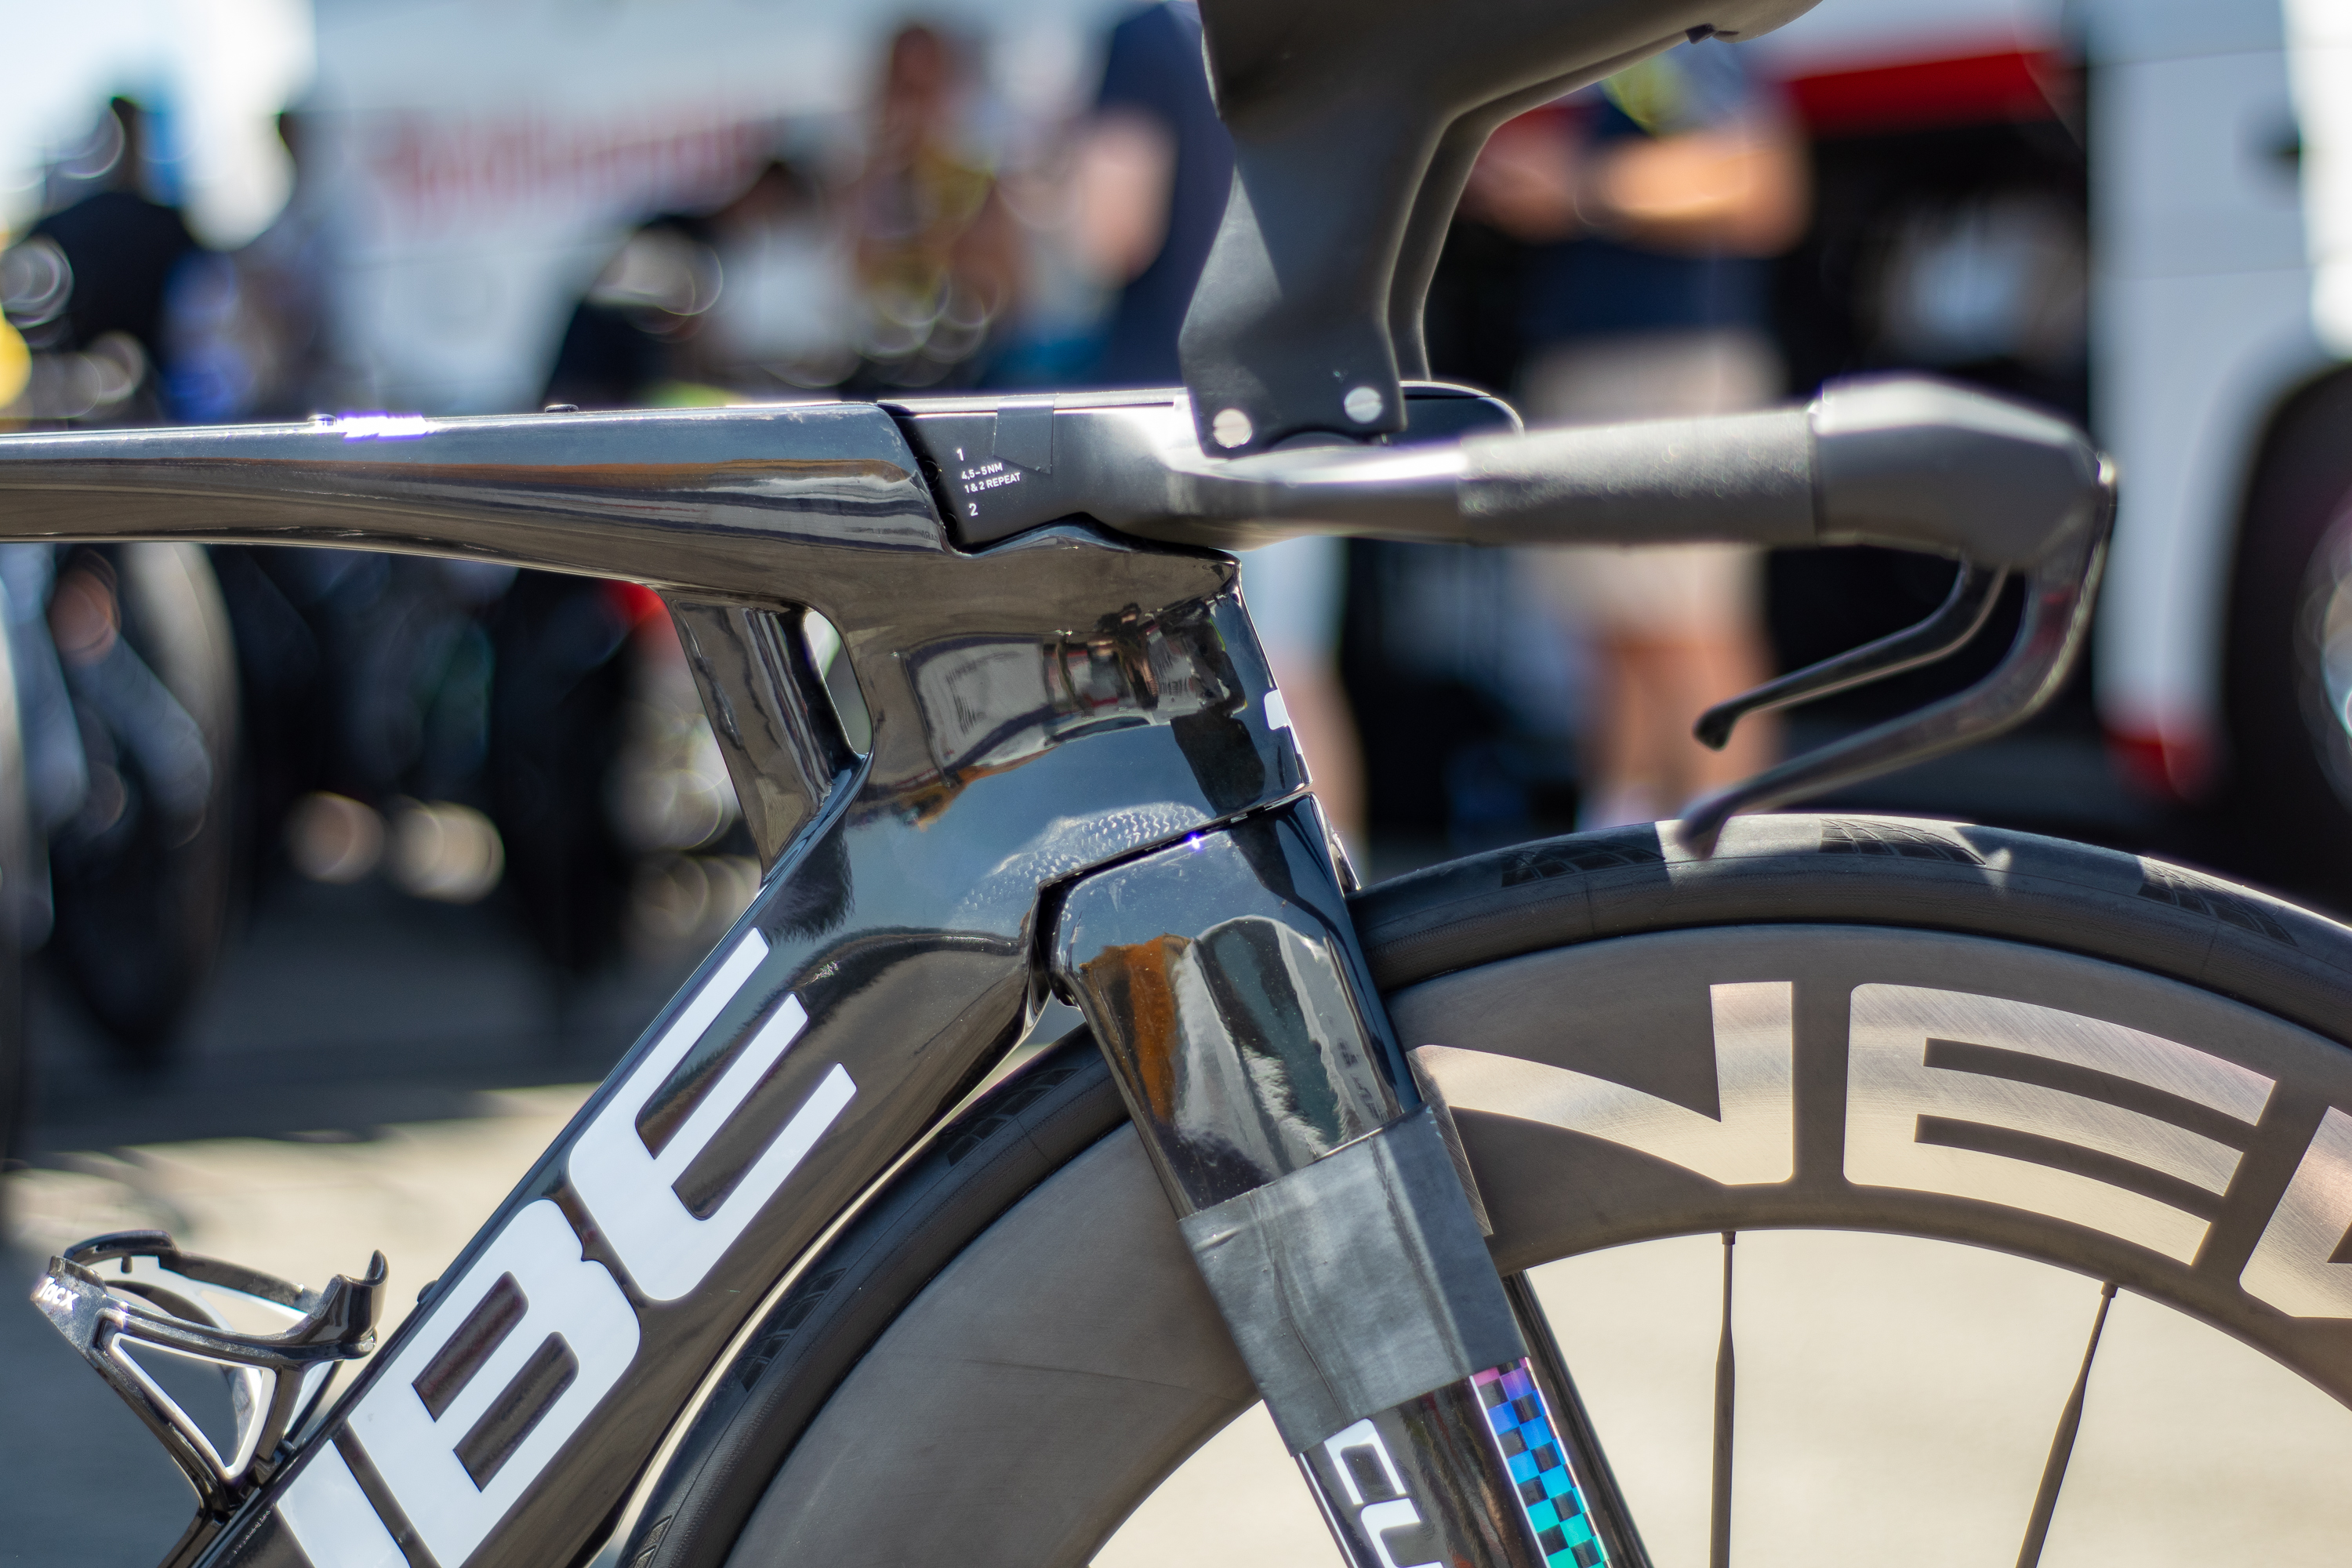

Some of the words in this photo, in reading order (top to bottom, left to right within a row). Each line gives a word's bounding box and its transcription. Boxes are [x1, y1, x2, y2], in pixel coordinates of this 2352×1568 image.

[956, 448, 964, 462] 1
[964, 485, 970, 494] 1
[971, 483, 978, 492] &
[978, 481, 985, 491] 2
[985, 472, 1021, 488] REPEAT
[968, 503, 978, 517] 2
[38, 1276, 79, 1311] Tacx
